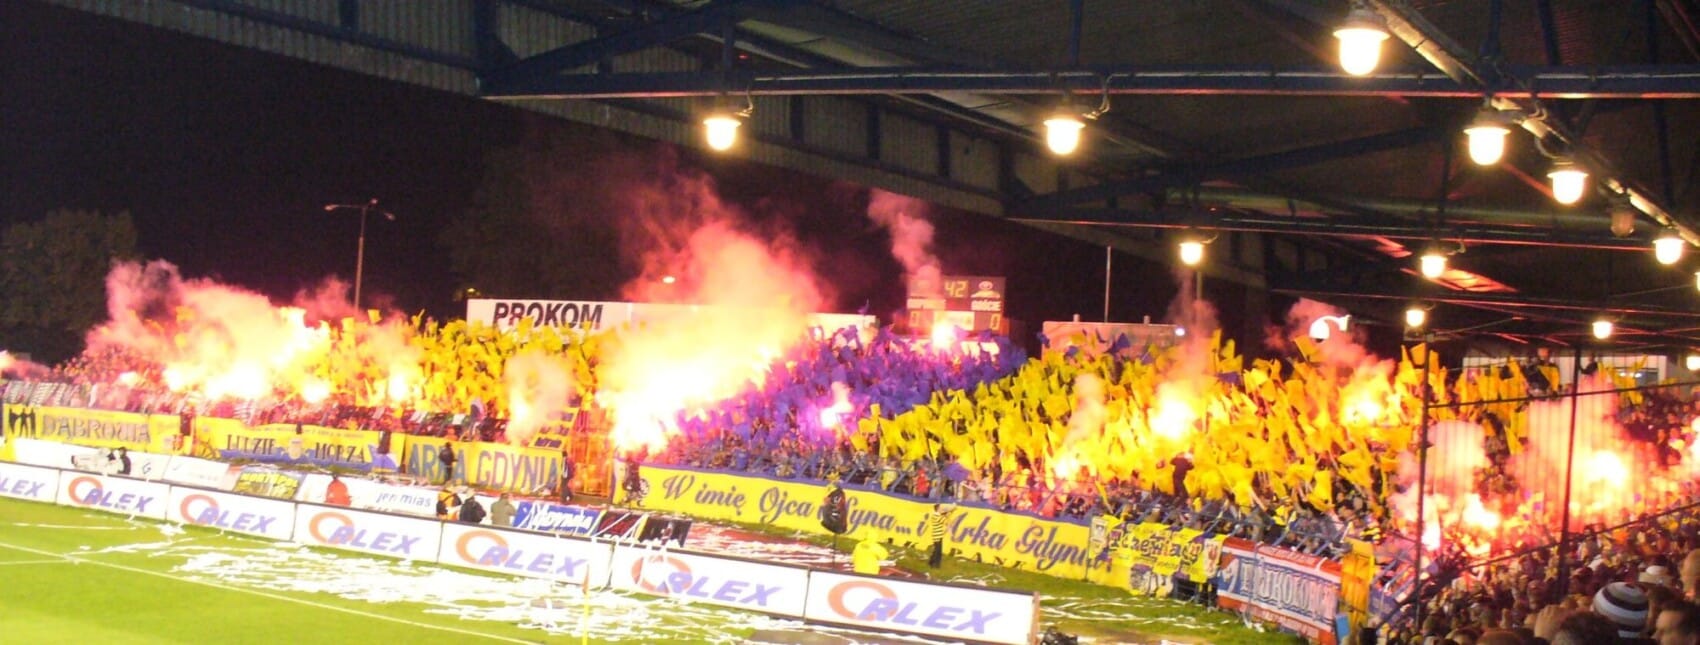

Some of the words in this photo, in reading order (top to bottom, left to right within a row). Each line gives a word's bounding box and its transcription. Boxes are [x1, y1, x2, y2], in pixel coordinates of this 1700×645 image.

[945, 280, 968, 298] 42
[493, 302, 603, 330] PROKOM
[476, 450, 559, 492] GDYNIA
[68, 476, 153, 513] ORLEX
[180, 494, 277, 533] ORLEX
[375, 492, 432, 508] jermias
[662, 474, 695, 500] W
[695, 483, 746, 516] imię
[758, 486, 815, 523] Ojca
[915, 512, 930, 537] i
[944, 511, 1010, 551] Arka
[308, 511, 421, 555] ORLEX
[455, 530, 587, 577] ORLEX
[630, 554, 784, 607] ORLEX
[827, 580, 1002, 634] ORLEX
